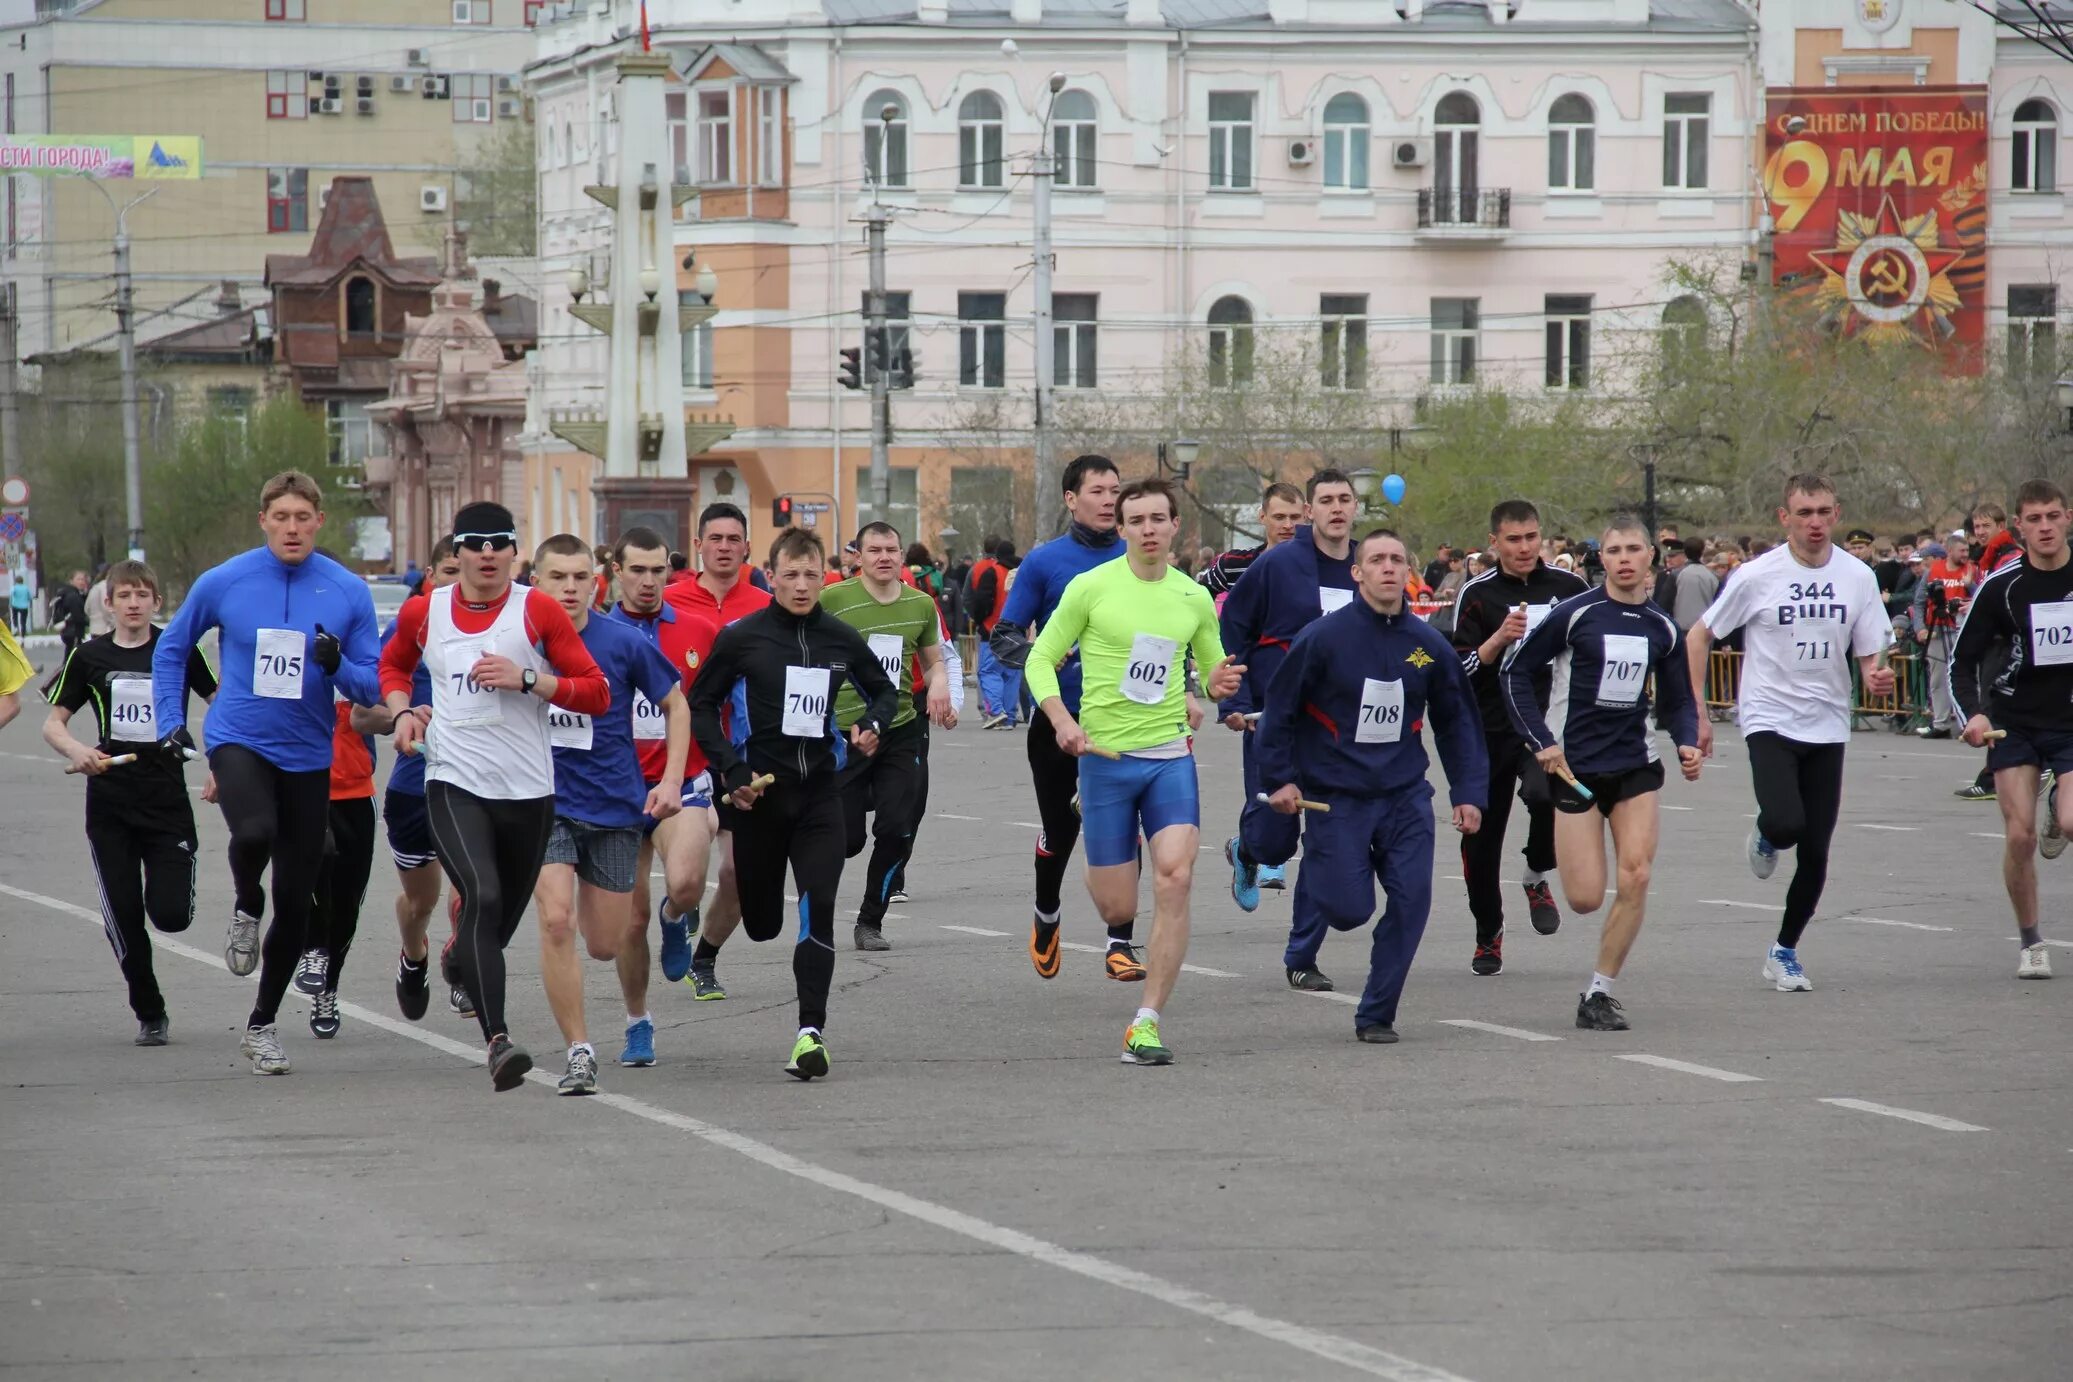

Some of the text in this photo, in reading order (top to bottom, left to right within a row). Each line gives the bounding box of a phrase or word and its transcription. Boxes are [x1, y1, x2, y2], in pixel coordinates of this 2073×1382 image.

[1876, 112, 1985, 134] ПОБЕДЫ!
[37, 147, 111, 171] ГОРОДА!
[1765, 140, 1954, 232] 9 МАЯ
[1789, 582, 1836, 601] 344
[1779, 604, 1847, 625] ВШП
[2035, 626, 2073, 647] 702
[1796, 641, 1830, 660] 711
[260, 655, 301, 676] 705
[880, 656, 900, 672] 00
[1129, 660, 1167, 685] 602
[1606, 660, 1643, 681] 707
[113, 703, 152, 723] 403
[636, 699, 663, 718] 60
[789, 693, 825, 716] 700
[1361, 704, 1400, 724] 708
